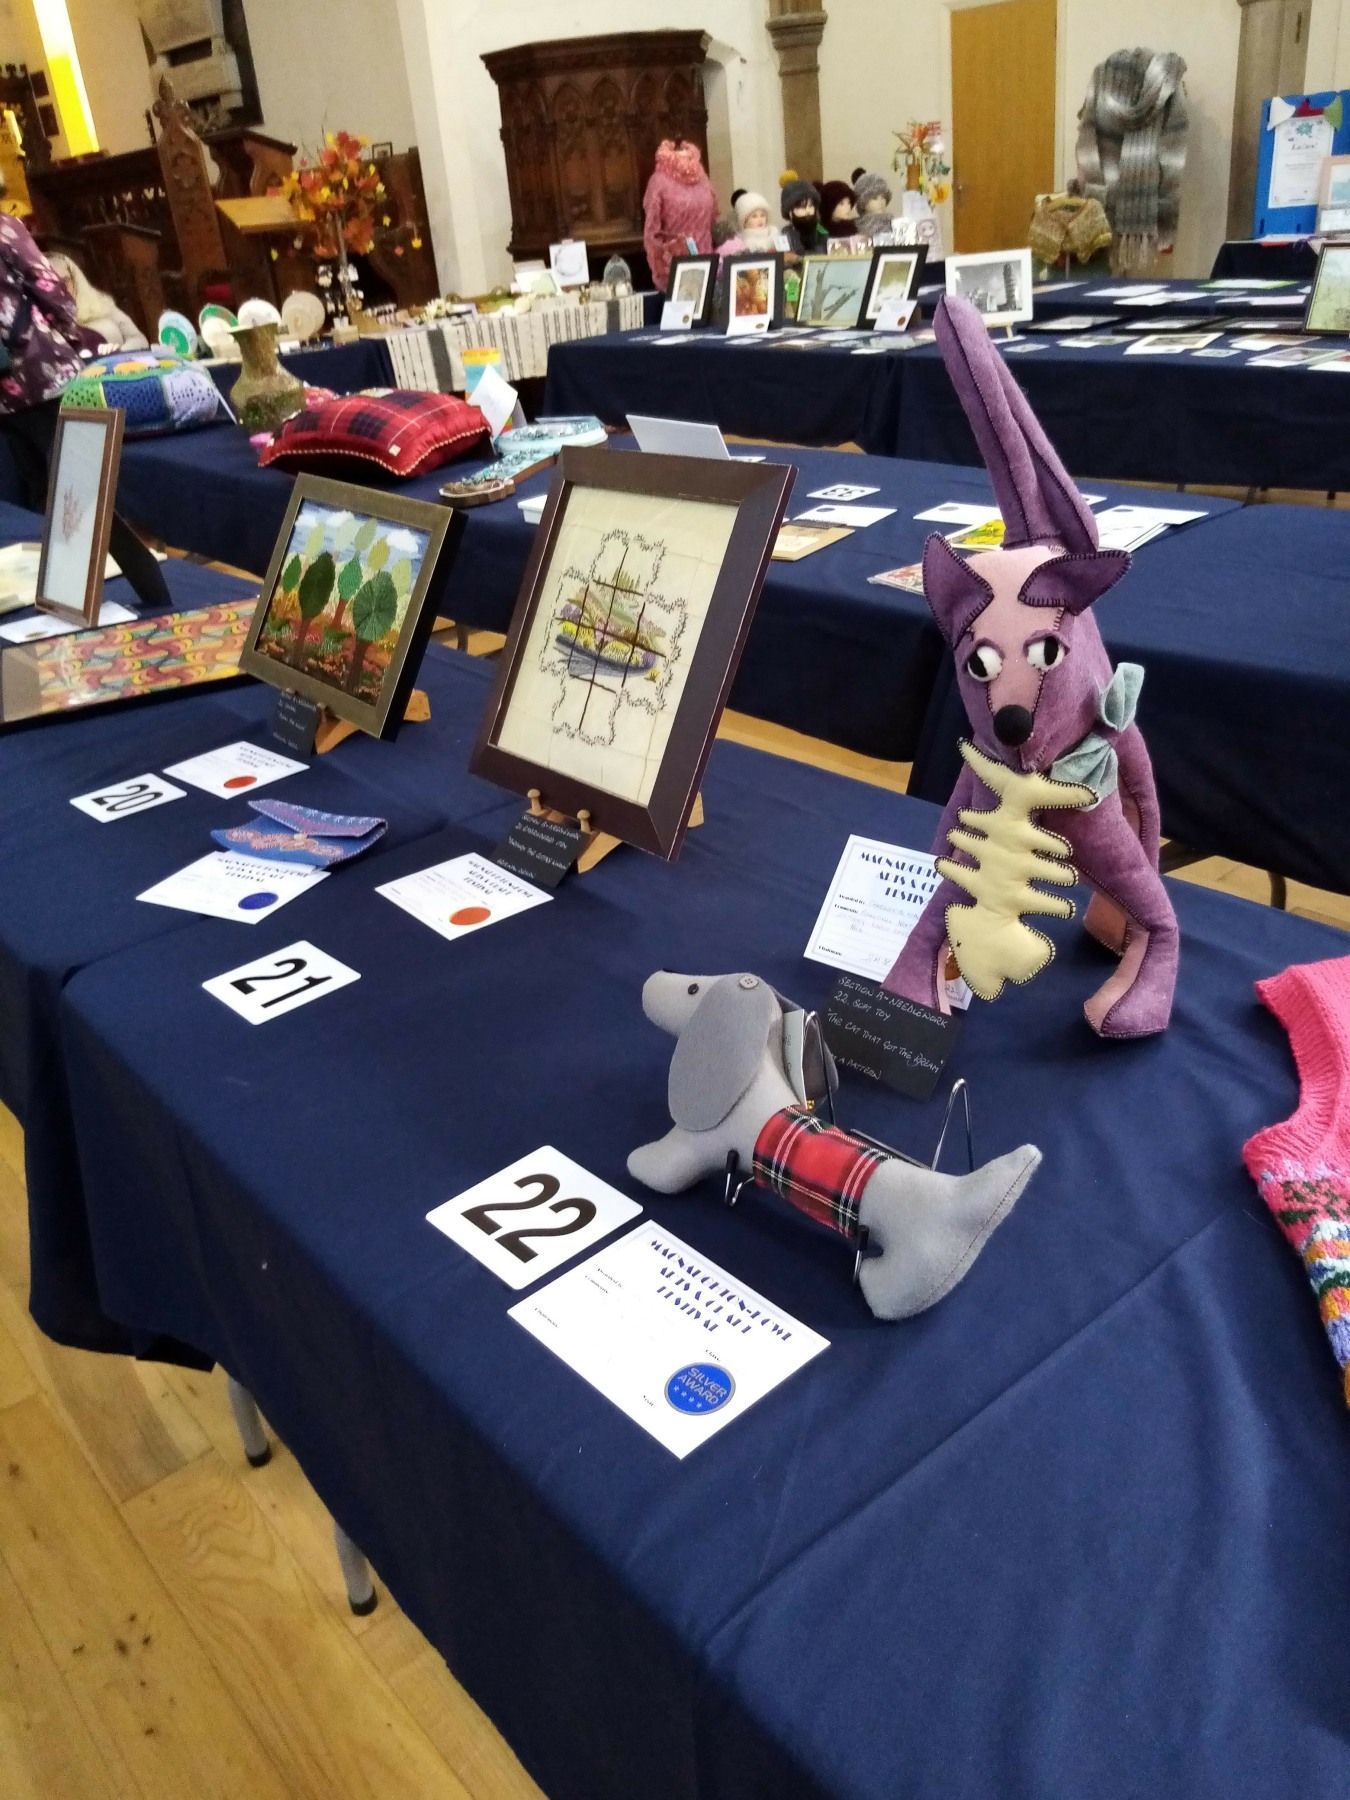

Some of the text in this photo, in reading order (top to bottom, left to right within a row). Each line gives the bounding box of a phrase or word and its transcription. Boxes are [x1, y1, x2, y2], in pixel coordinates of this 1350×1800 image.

[91, 784, 164, 812] 20
[230, 958, 333, 1009] 21
[838, 976, 875, 997] SECTION
[875, 1008, 892, 1022] TOY
[460, 1173, 597, 1264] 22
[678, 1374, 719, 1405] AWARD
[687, 1367, 727, 1398] SILVER
